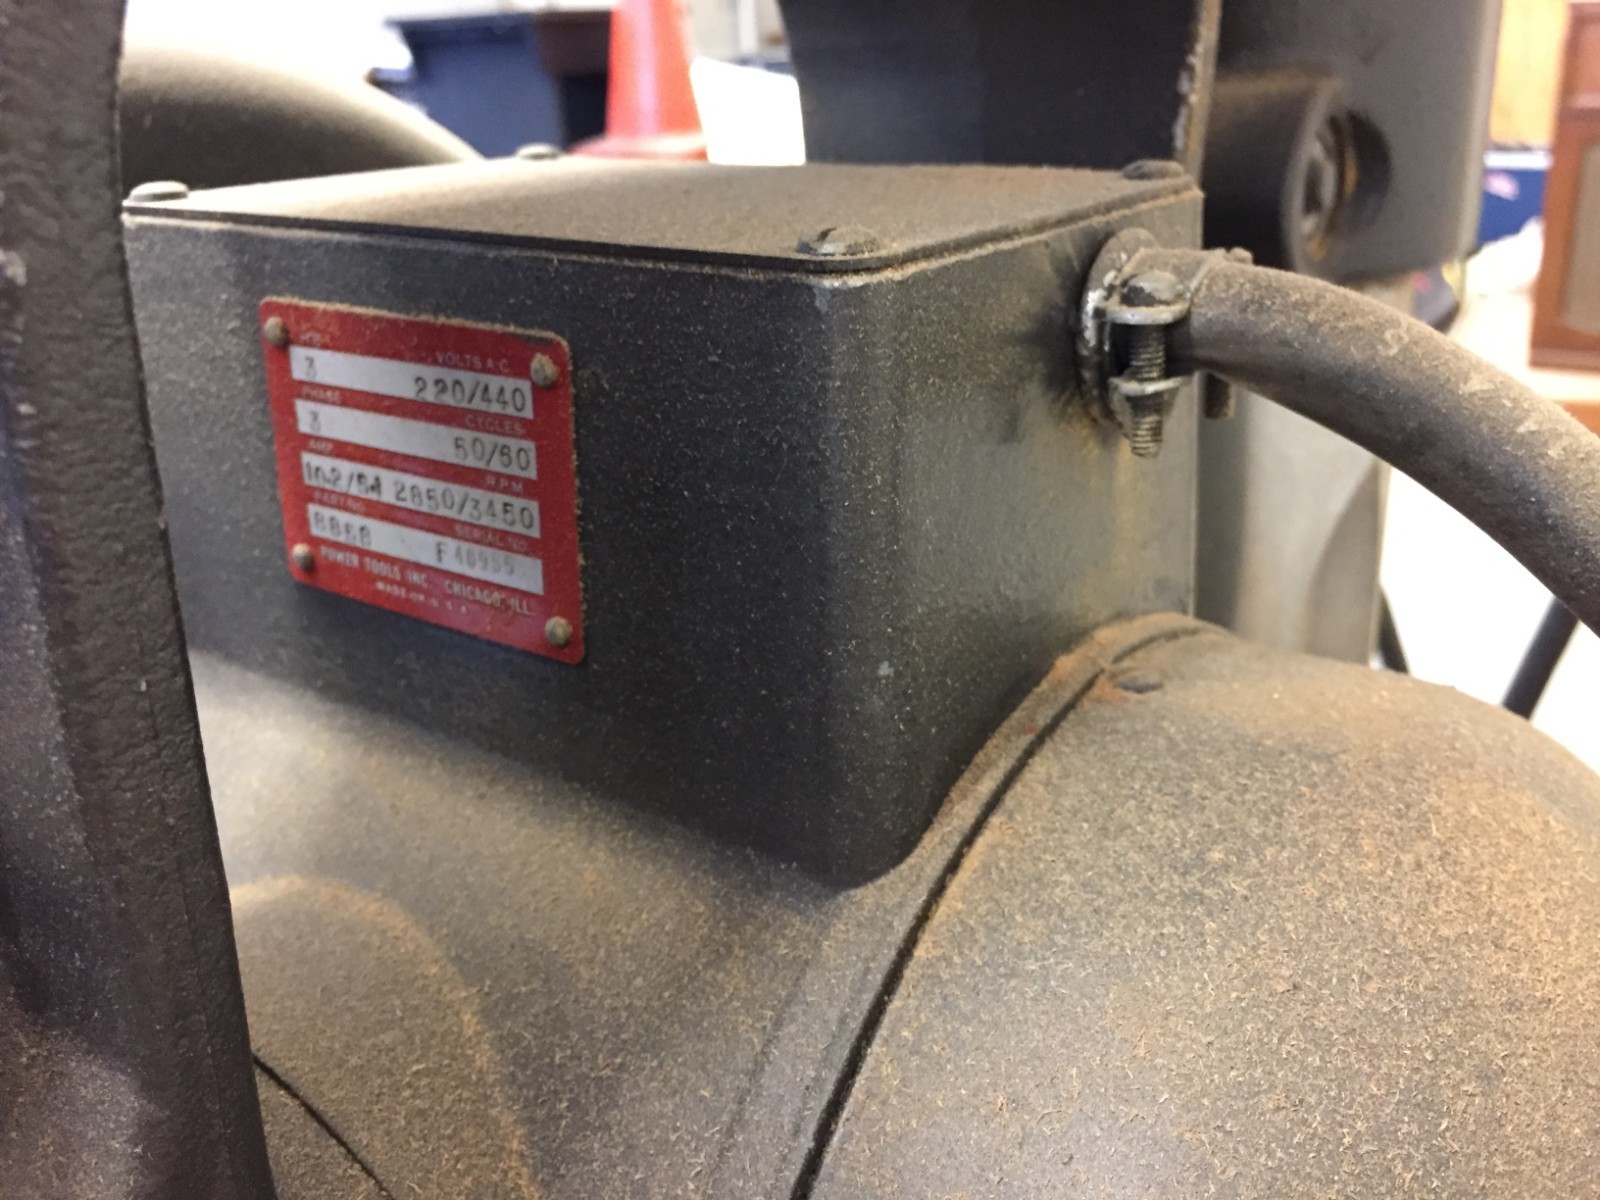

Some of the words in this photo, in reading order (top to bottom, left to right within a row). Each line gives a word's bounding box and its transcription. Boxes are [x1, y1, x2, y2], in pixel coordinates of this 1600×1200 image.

[435, 350, 483, 371] VOLTS
[413, 374, 527, 413] 220/440
[453, 436, 531, 471] 50/60
[393, 480, 535, 530] 2850/3450
[364, 556, 402, 581] TOOLS
